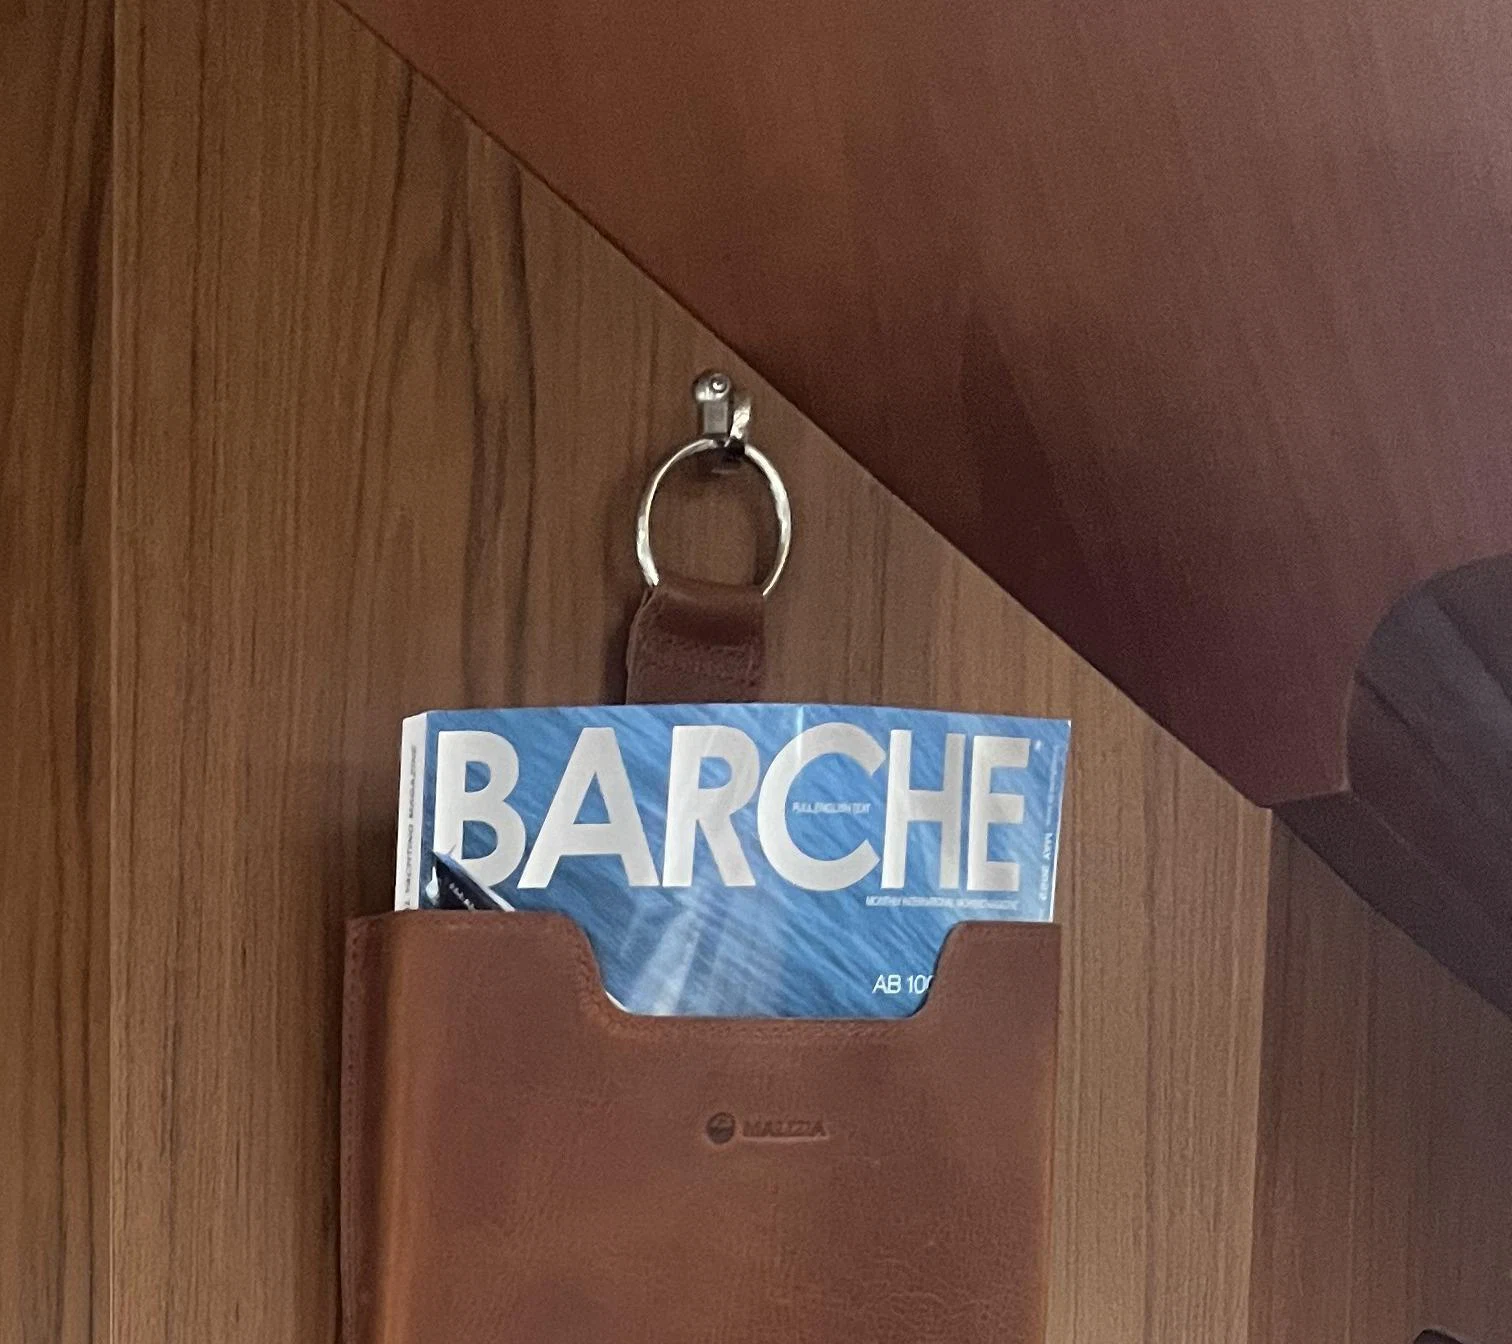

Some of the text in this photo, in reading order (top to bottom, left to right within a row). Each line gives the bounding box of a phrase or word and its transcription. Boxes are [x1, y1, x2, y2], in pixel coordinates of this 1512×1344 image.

[433, 722, 1031, 892] BARCHE
[1043, 832, 1053, 860] MAY
[872, 974, 902, 994] AB
